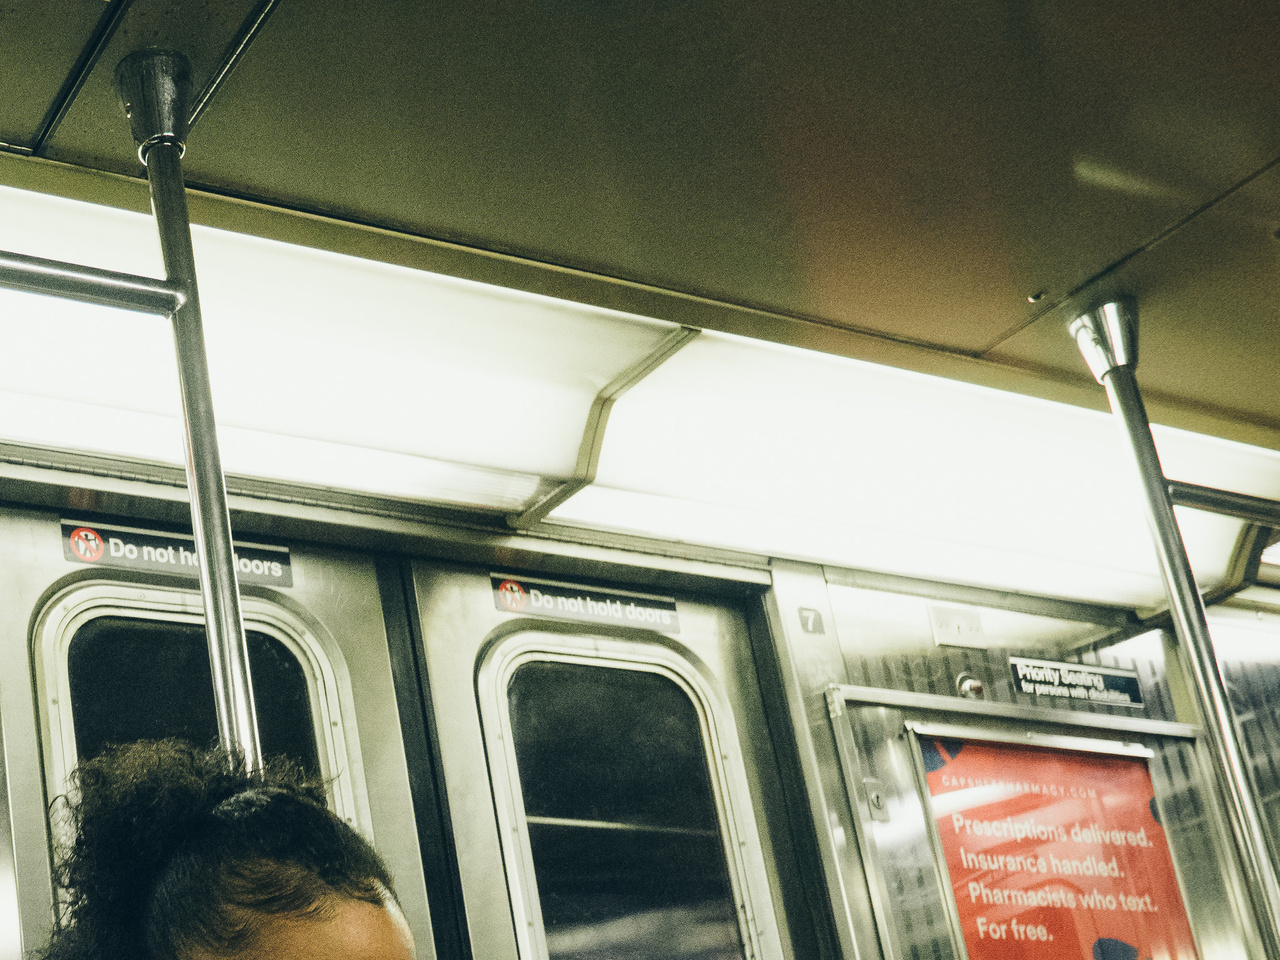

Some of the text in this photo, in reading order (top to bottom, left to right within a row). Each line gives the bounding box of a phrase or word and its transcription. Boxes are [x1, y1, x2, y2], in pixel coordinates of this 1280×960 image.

[109, 537, 138, 559] Do
[143, 546, 175, 564] not
[529, 589, 671, 625] Do not hold doors
[802, 611, 816, 632] 7
[1017, 664, 1105, 690] Priority Seating
[952, 813, 1154, 848] Prescriptions delivered.
[960, 847, 1125, 878] Insurance handled.
[968, 882, 1159, 912] Pharmacists who text.
[977, 917, 1054, 941] For free.
